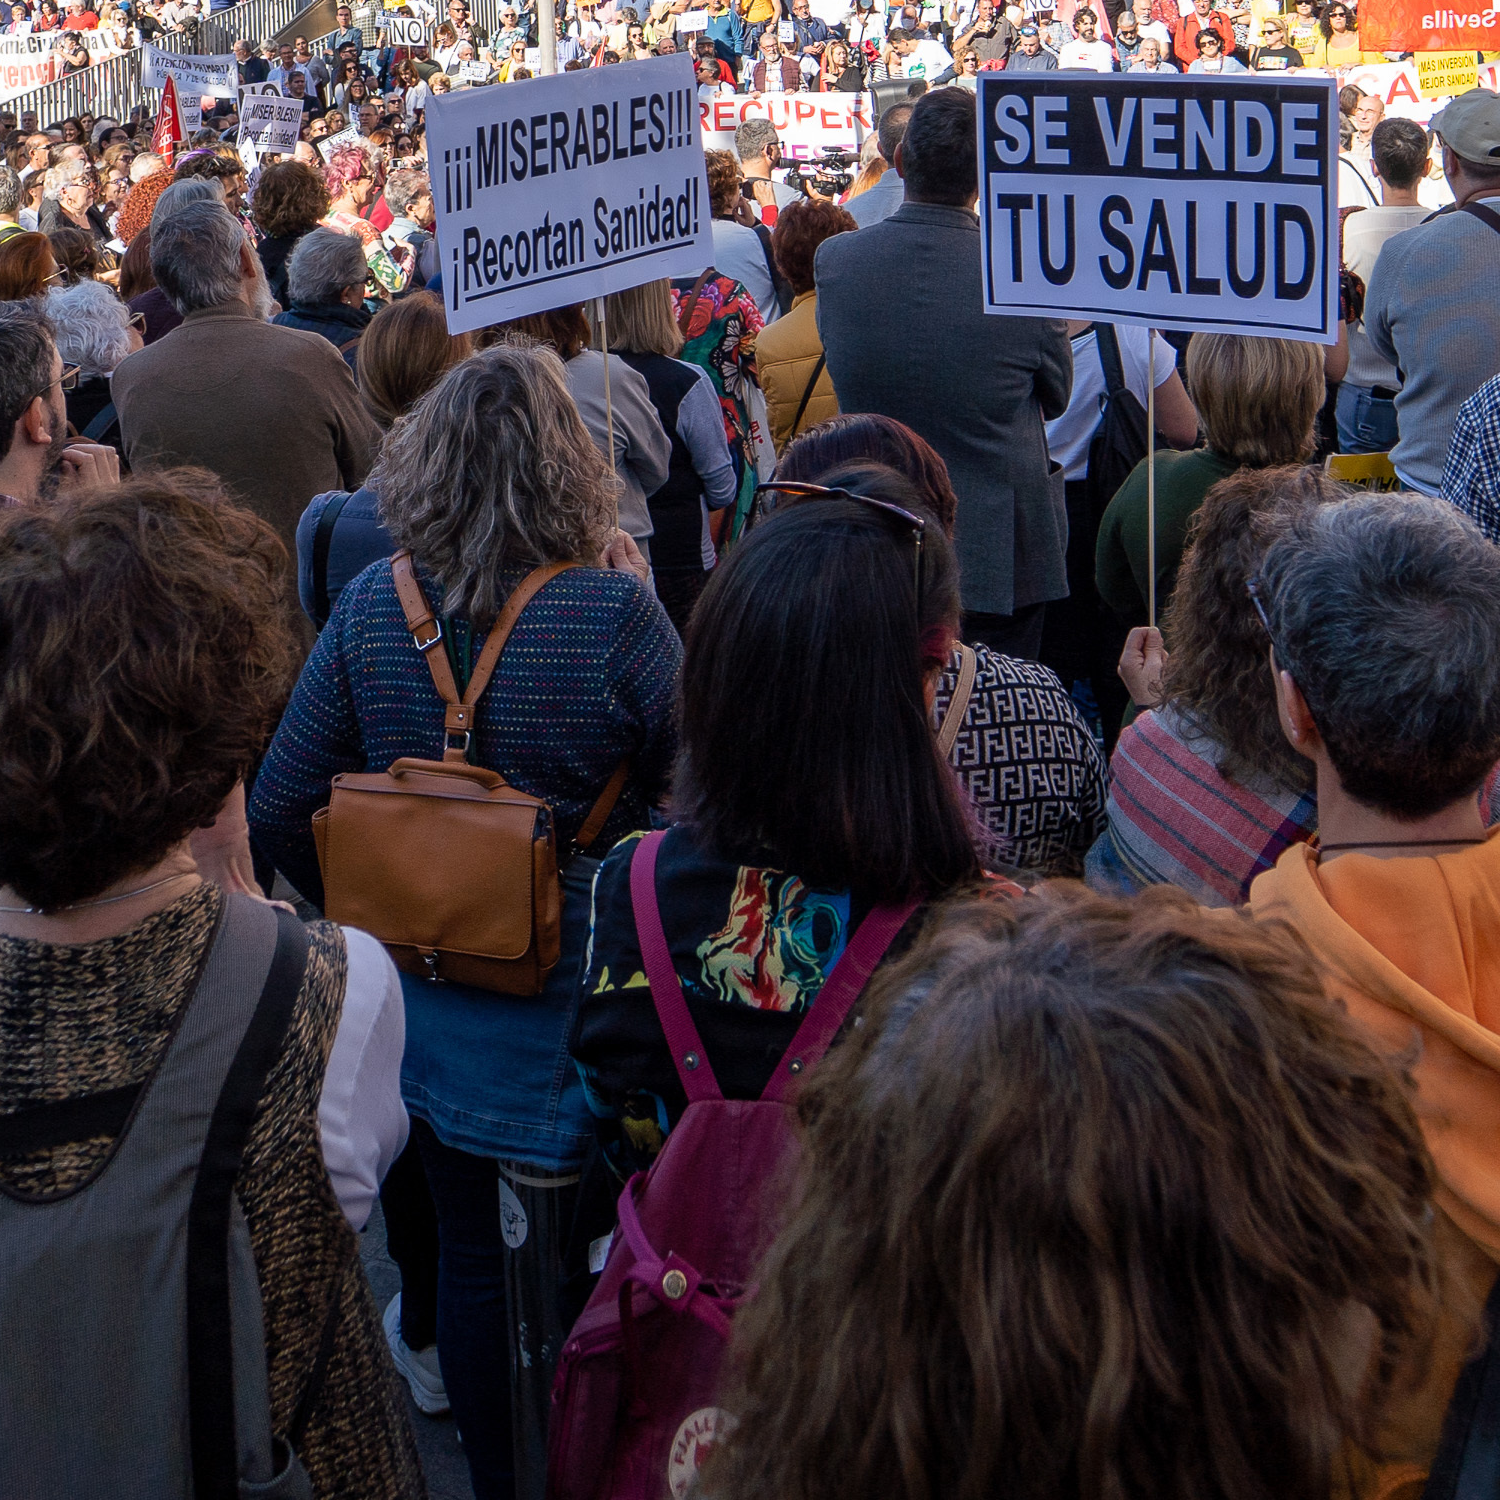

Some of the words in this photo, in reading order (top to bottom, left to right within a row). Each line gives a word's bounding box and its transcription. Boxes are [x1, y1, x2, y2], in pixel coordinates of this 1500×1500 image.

[393, 19, 422, 45] NO
[1419, 74, 1446, 90] MEJOR
[993, 93, 1071, 166] SE
[1093, 96, 1320, 177] VENDE
[452, 210, 585, 312] ¡Recortan
[592, 176, 700, 259] Sanidad!
[996, 192, 1077, 287] TU
[1098, 193, 1317, 301] SALUD
